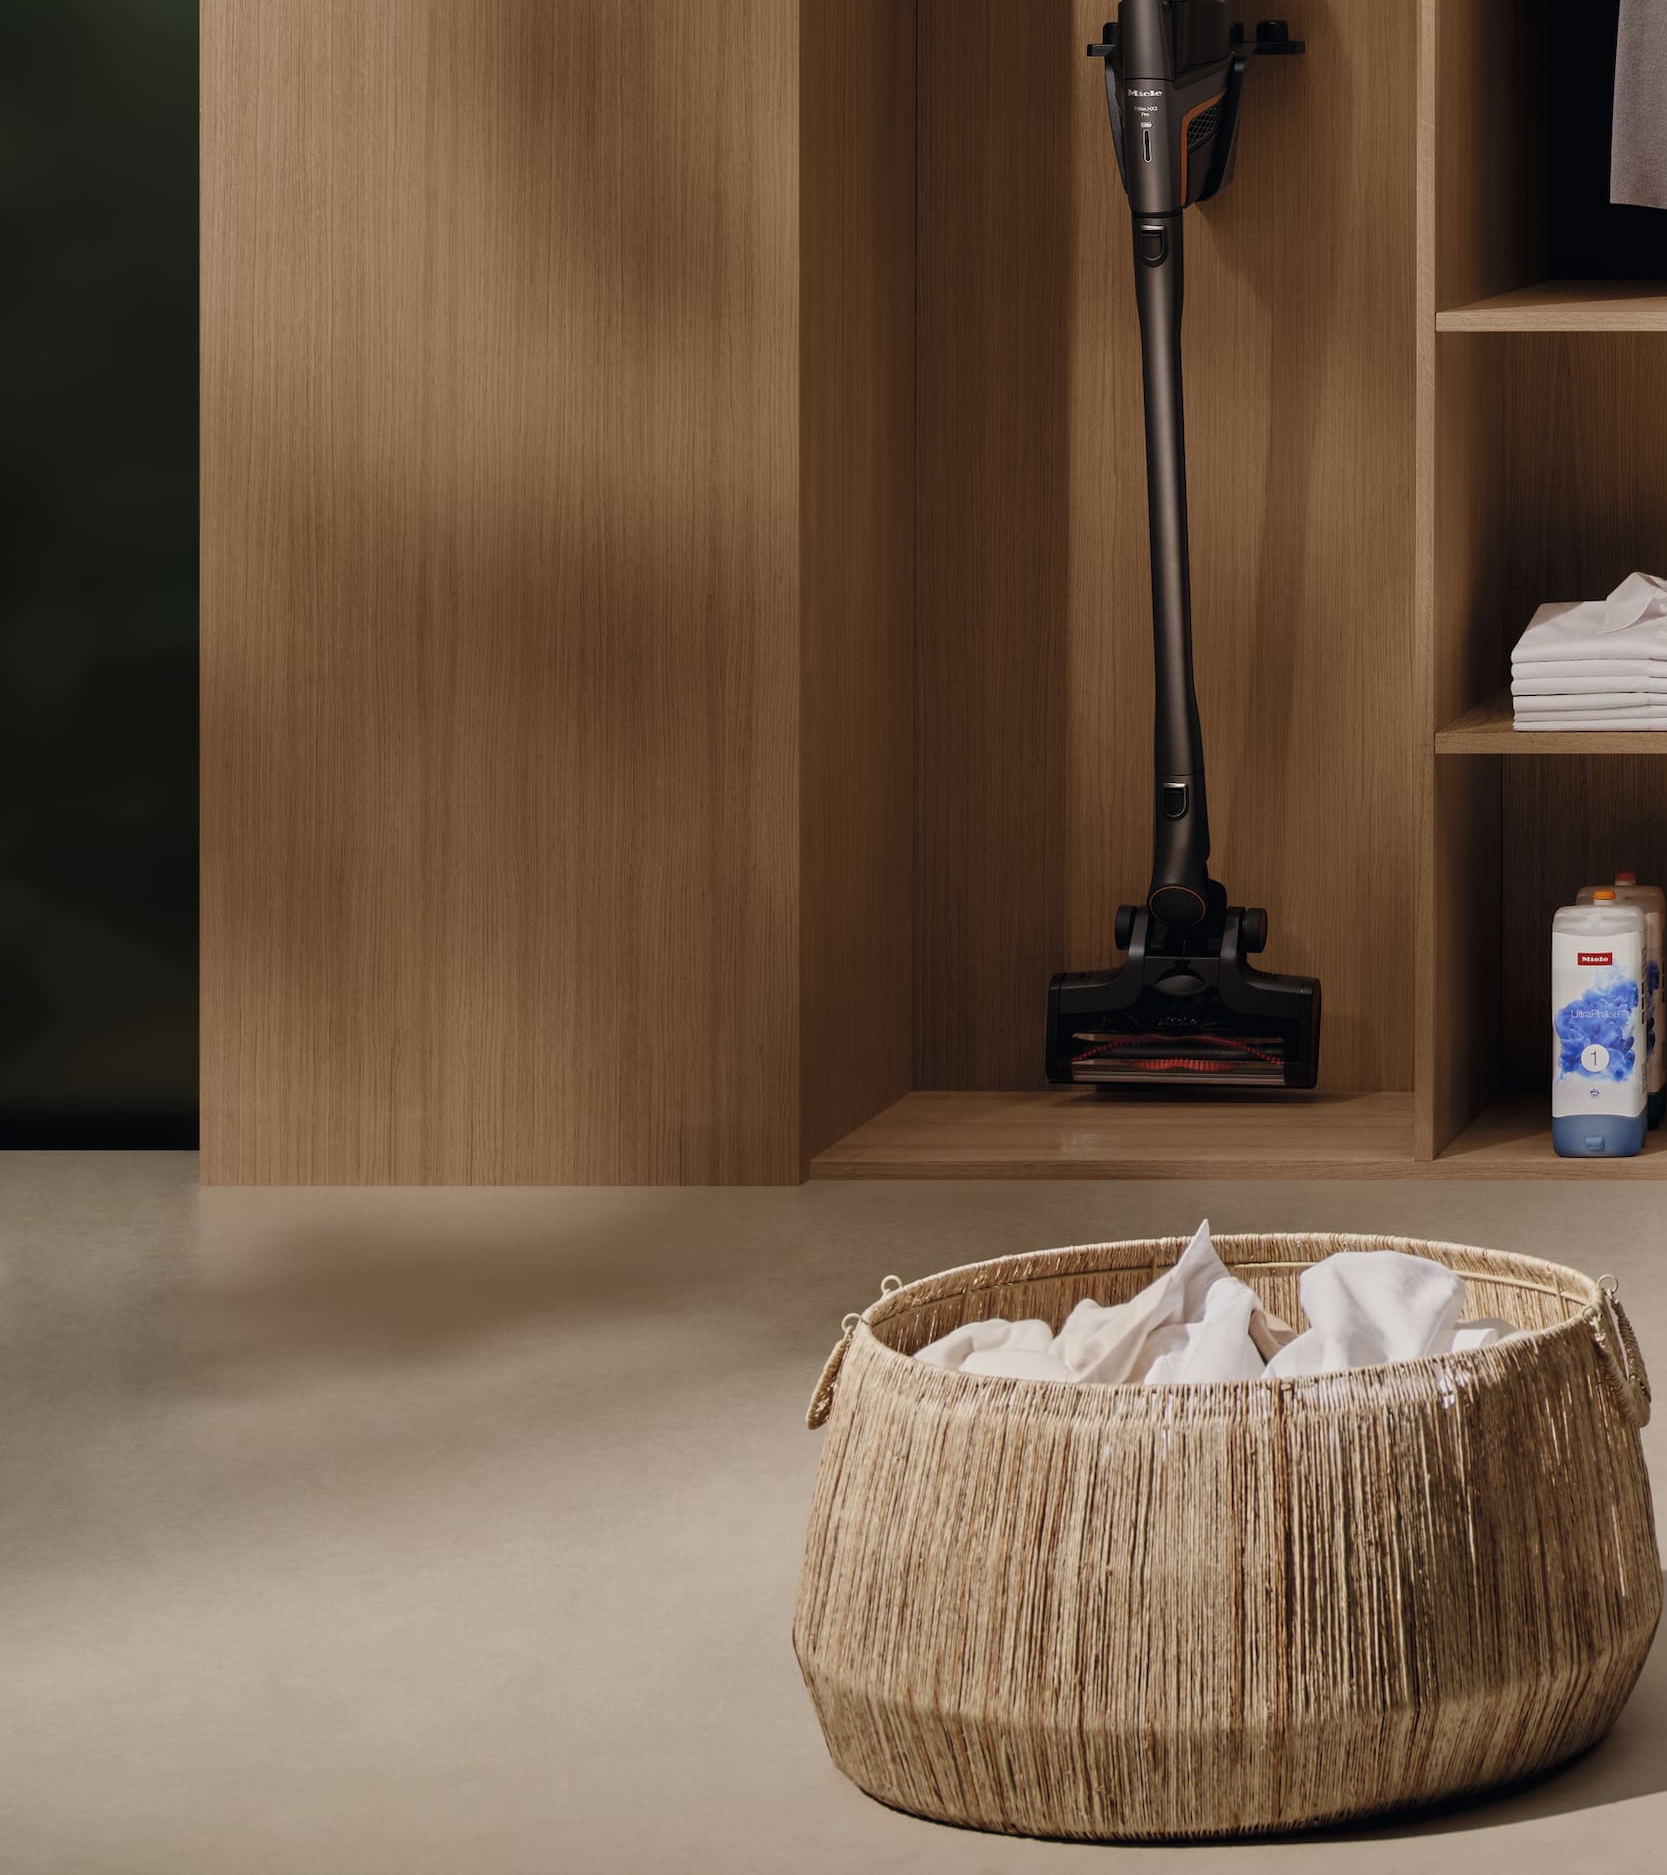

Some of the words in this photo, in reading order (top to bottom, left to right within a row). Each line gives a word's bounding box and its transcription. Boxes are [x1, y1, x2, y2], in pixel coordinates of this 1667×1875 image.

[1128, 89, 1163, 97] Miele
[1571, 1009, 1621, 1019] UltraPhase
[1590, 1050, 1598, 1066] 1
